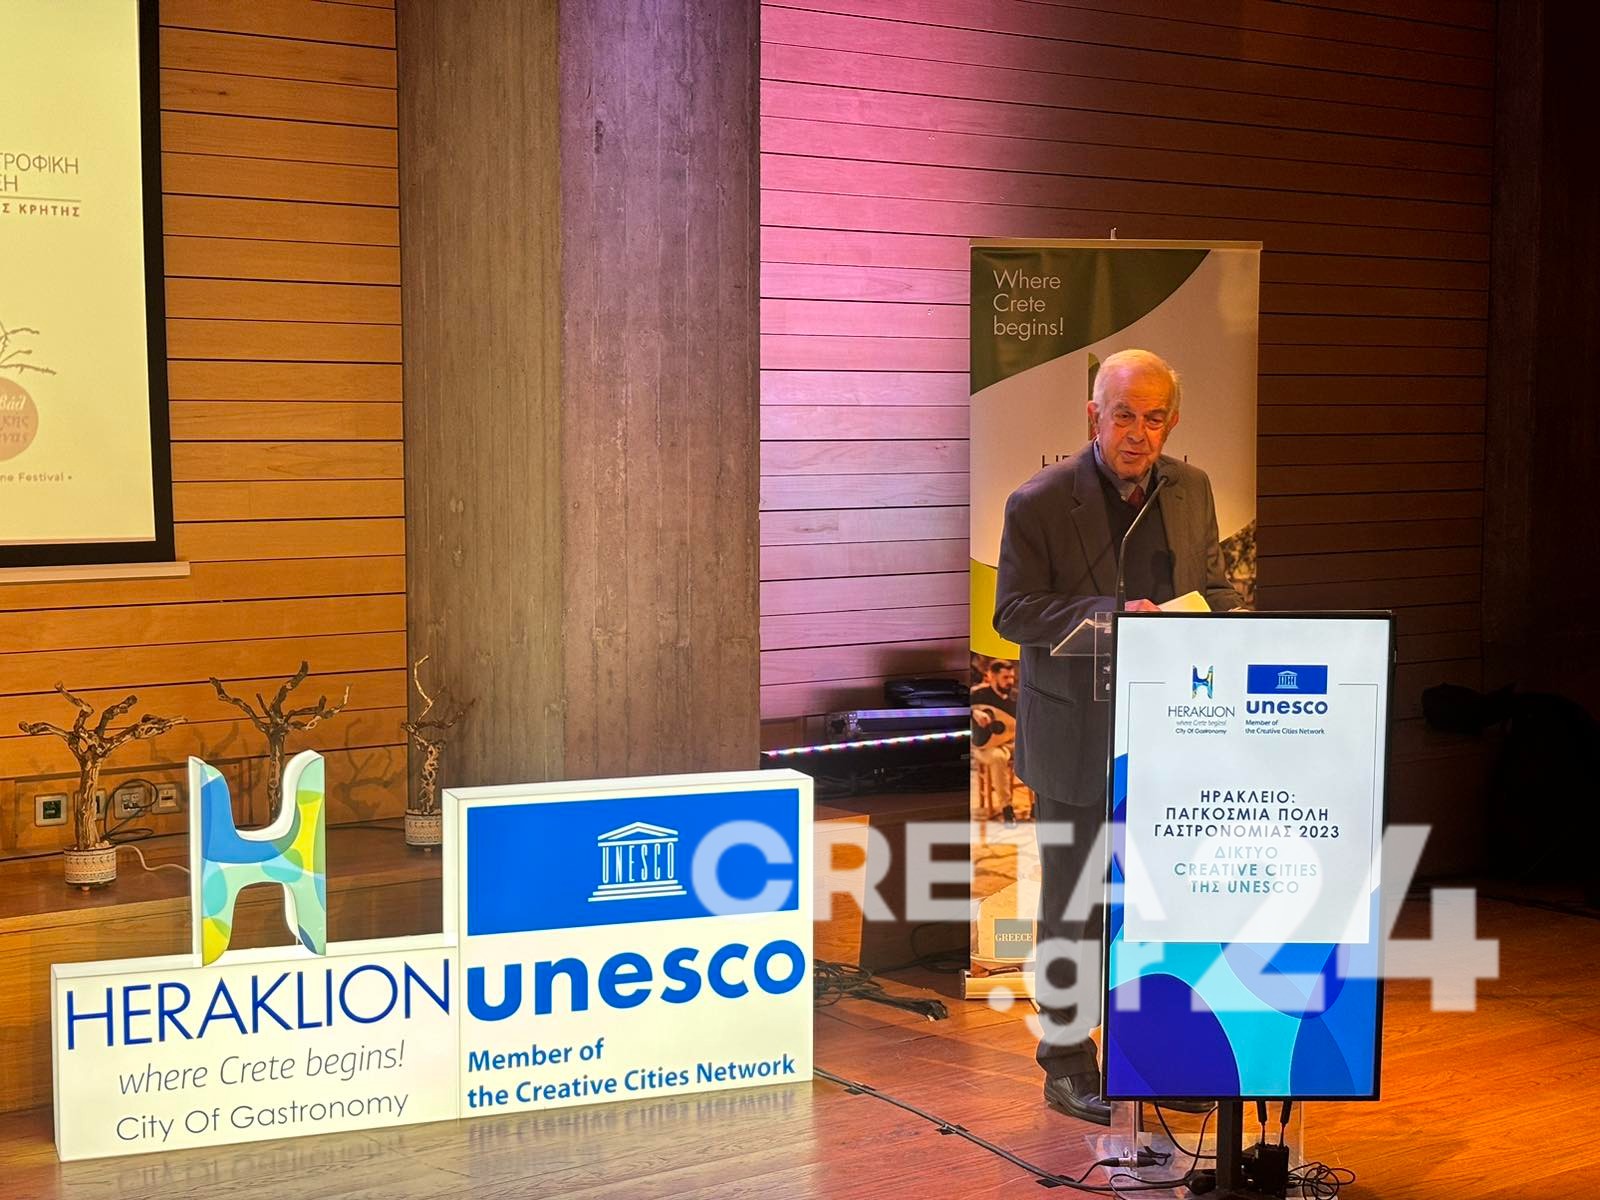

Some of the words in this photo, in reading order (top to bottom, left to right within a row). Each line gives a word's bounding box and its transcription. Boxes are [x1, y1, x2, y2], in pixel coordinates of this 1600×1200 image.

[19, 204, 80, 217] ΚΡΗΤΗΣ
[993, 269, 1061, 289] Where
[993, 293, 1046, 313] Crete
[993, 315, 1064, 341] begins!
[18, 472, 64, 482] Festival
[1168, 706, 1235, 717] HERAKLION
[1246, 700, 1328, 714] unesco
[1200, 790, 1296, 803] ΗΡΑΚΛΕΙΟ:
[1166, 807, 1270, 820] ΠΑΓΚΟΣΜΙΑ
[1278, 808, 1329, 821] ΠΟΛΗ
[1154, 824, 1292, 837] ΓΑΣΤΡΟΝΟΜΙΑΣ
[1299, 825, 1340, 838] 2023
[1214, 846, 1278, 859] ΔΙΚΤΥΟ
[601, 842, 675, 884] UNESCO
[1174, 863, 1257, 876] CREATIVE
[1265, 864, 1317, 877] CITIES
[1192, 880, 1220, 893] ΤΗΣ
[1228, 881, 1299, 894] UNESCO
[995, 933, 1033, 942] GREECE
[467, 939, 806, 1022] unesco
[66, 958, 450, 1050] HERAKLION
[468, 1045, 573, 1073] Member
[579, 1037, 605, 1060] of
[119, 1063, 208, 1095] where
[220, 1054, 295, 1086] Crete
[306, 1039, 406, 1082] begins!
[467, 1085, 508, 1108] the
[515, 1074, 617, 1102] Creative
[624, 1067, 689, 1092] Cities
[696, 1053, 796, 1085] Network
[115, 1114, 174, 1143] City
[185, 1107, 220, 1134] Of
[230, 1093, 409, 1130] Gastronomy
